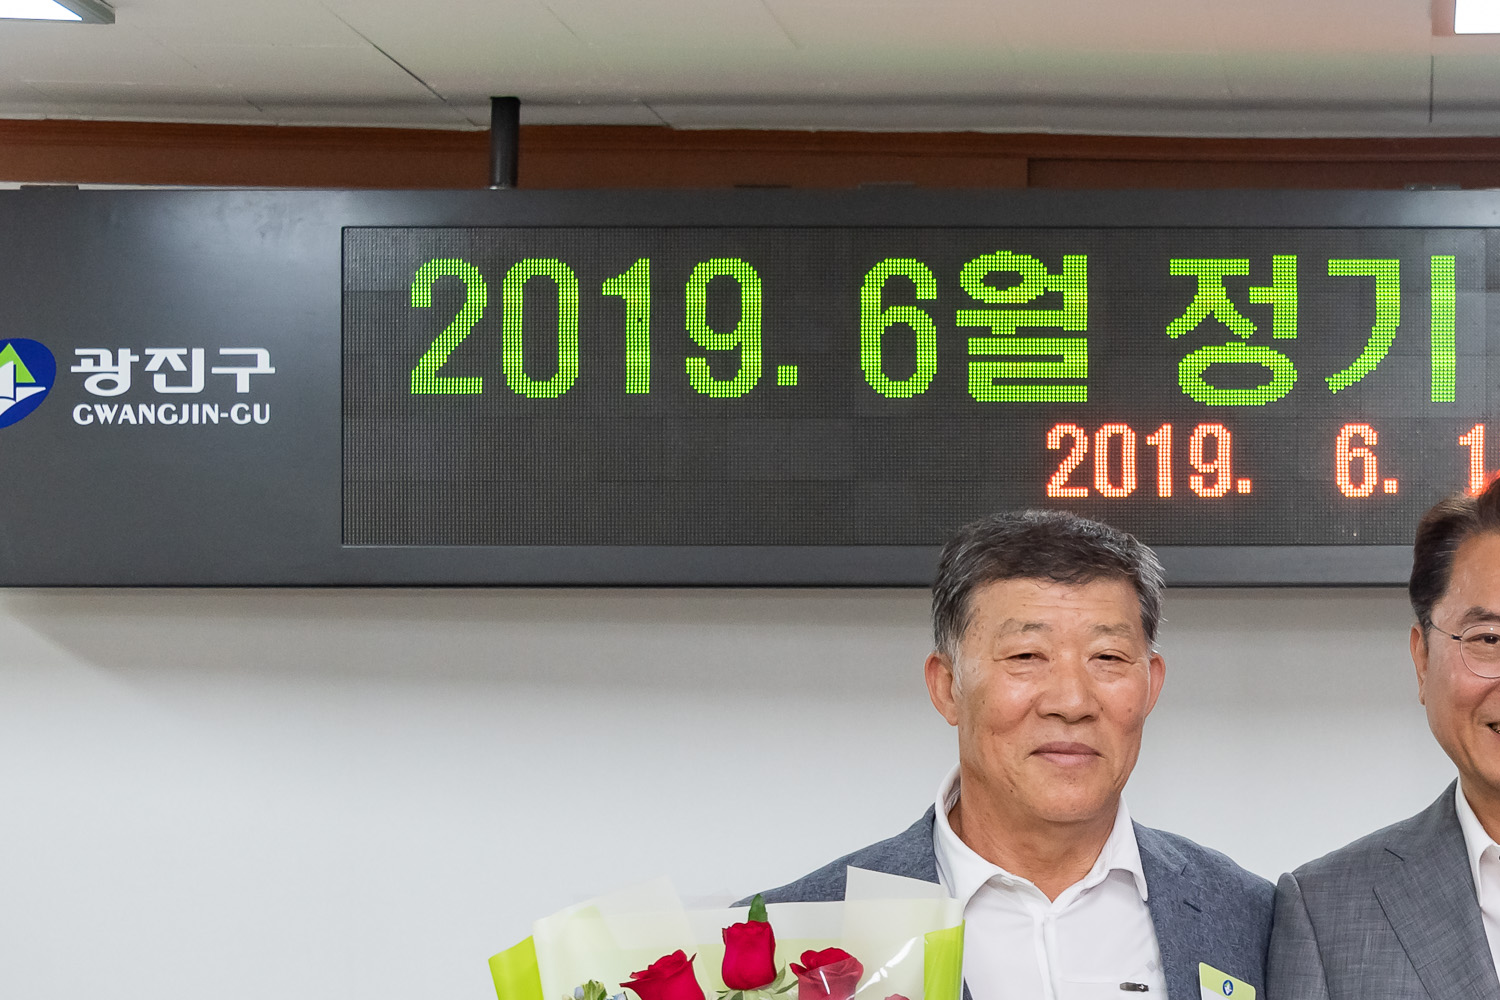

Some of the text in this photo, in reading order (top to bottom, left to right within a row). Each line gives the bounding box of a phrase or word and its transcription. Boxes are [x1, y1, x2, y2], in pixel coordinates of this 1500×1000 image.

[411, 257, 798, 399] 2019.
[860, 250, 1088, 403] 6월
[1165, 254, 1456, 407] 정기
[70, 347, 275, 396] 광진구
[72, 403, 270, 425] GWANGJIN-GU
[1046, 423, 1252, 498] 2019.
[1335, 423, 1398, 498] 6.
